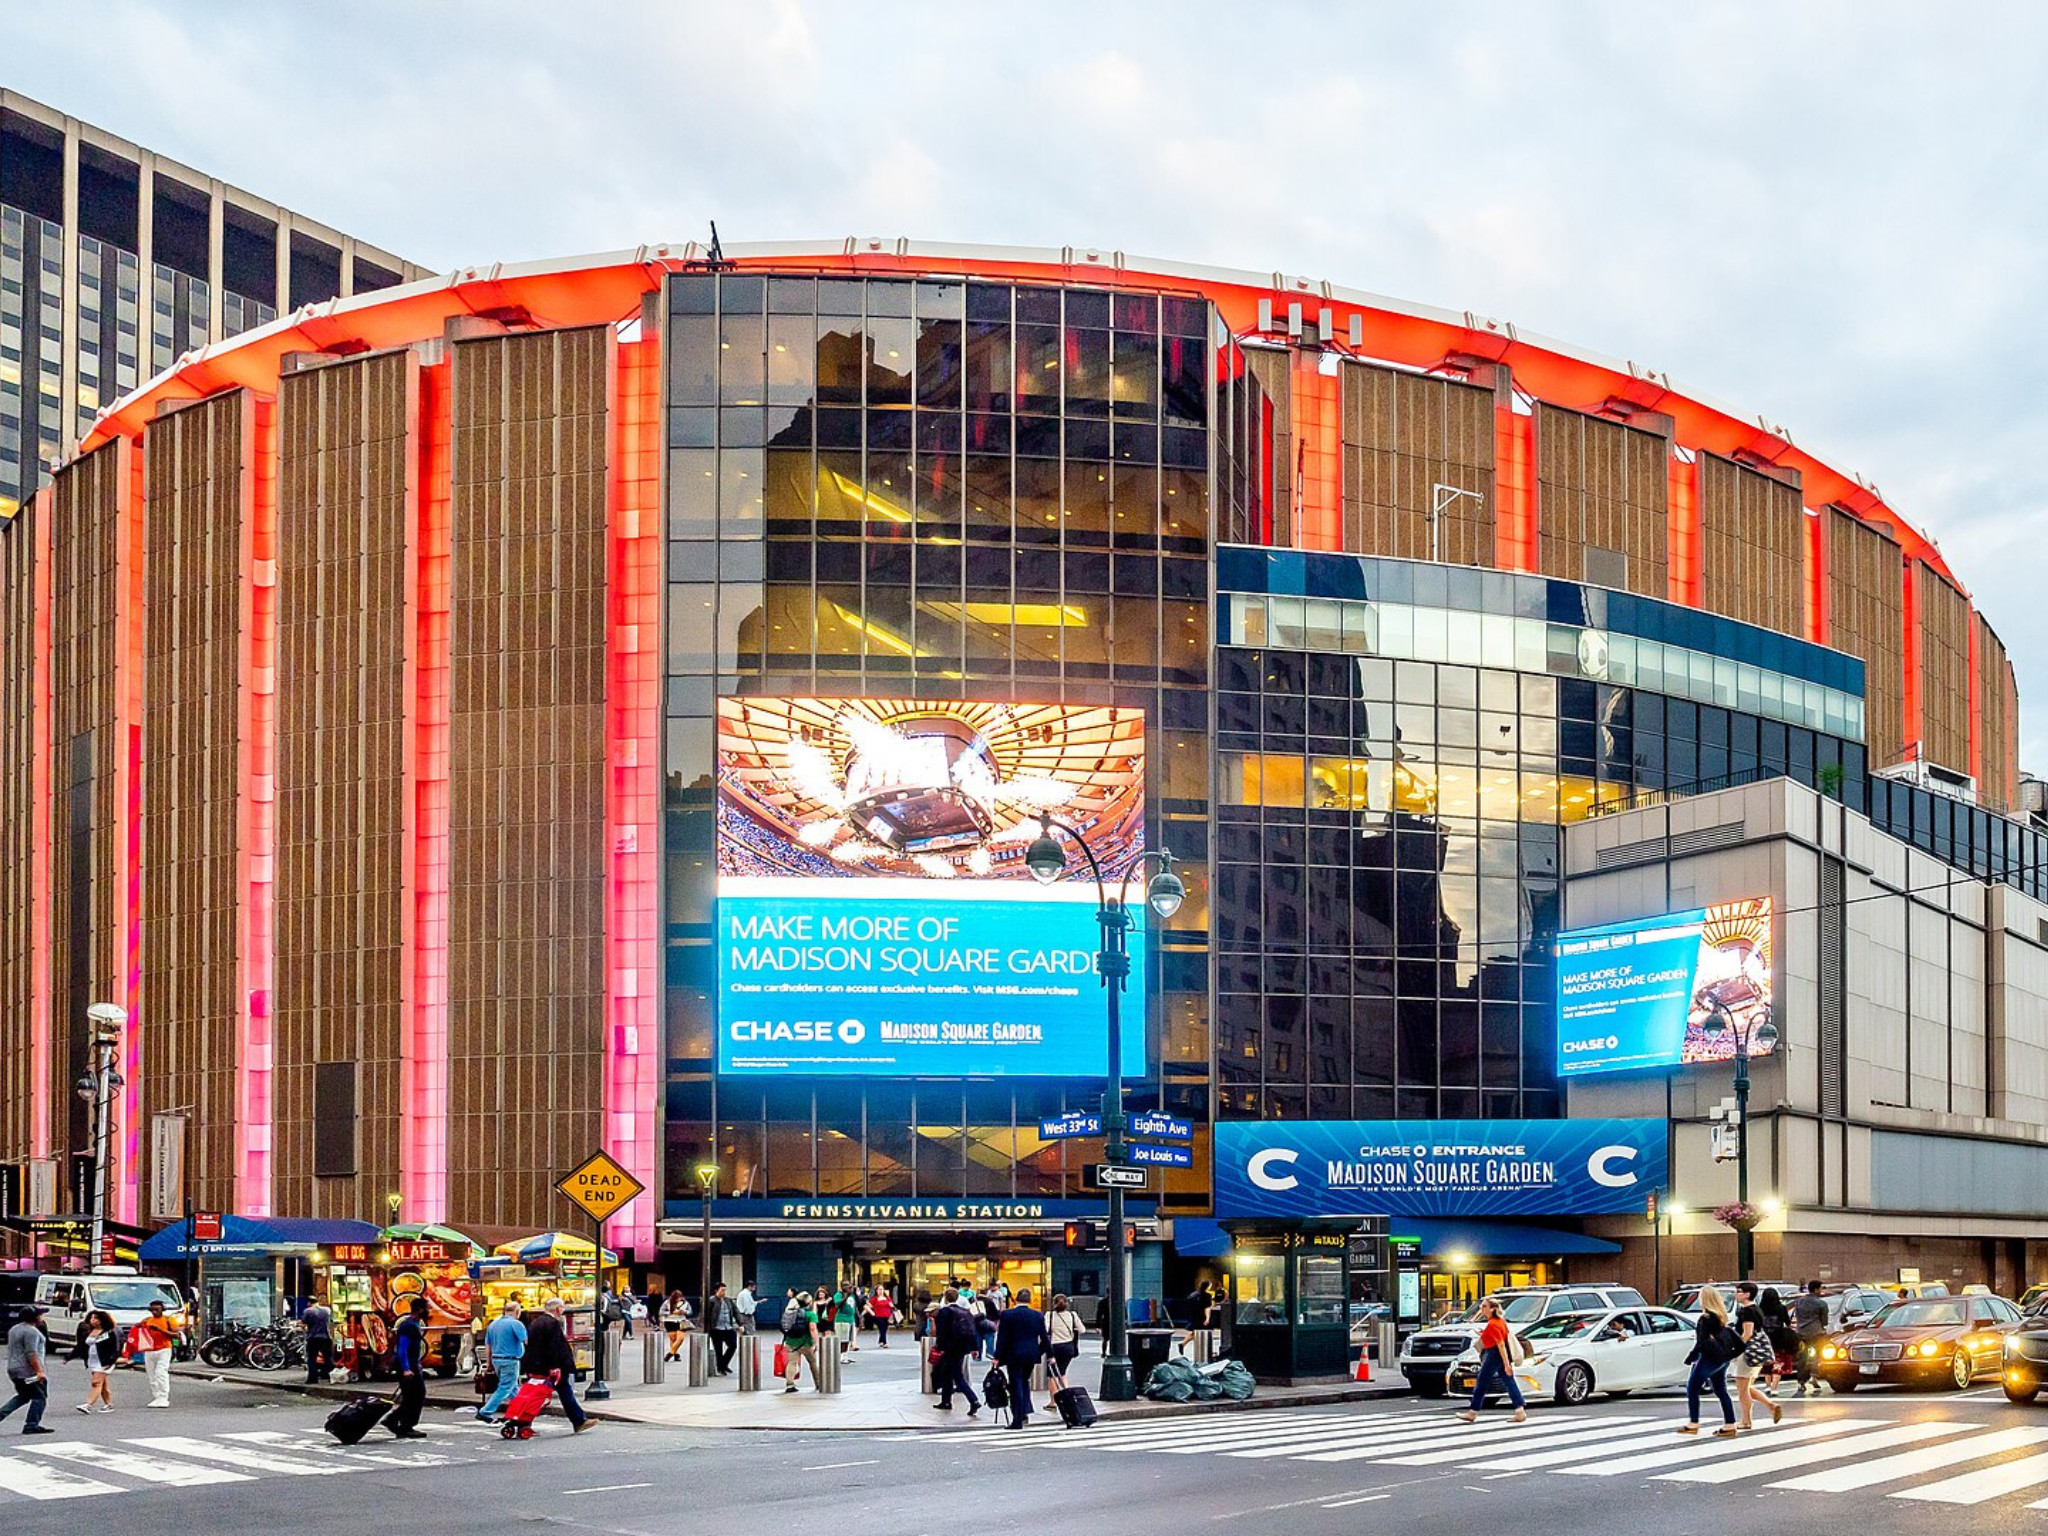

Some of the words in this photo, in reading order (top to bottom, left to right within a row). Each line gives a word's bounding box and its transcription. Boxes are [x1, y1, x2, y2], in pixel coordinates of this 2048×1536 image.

[731, 916, 812, 940] MAKE
[822, 916, 909, 941] MORE
[917, 917, 959, 941] OF
[731, 947, 872, 971] MADISON
[880, 947, 1000, 976] SQUARE
[1008, 949, 1101, 974] GARDE
[1562, 972, 1588, 985] MAKE
[1590, 967, 1618, 980] MORE
[1618, 965, 1633, 976] OF
[1562, 981, 1606, 995] MADISON
[1607, 974, 1646, 990] SQUARE
[1647, 968, 1688, 983] GARDEN
[731, 983, 761, 992] Chase
[764, 983, 823, 993] cardholders
[825, 985, 843, 993] can
[846, 985, 878, 993] access
[880, 985, 925, 994] exclusive
[927, 985, 970, 994] benefits.
[731, 1020, 834, 1041] CHASE
[881, 1021, 938, 1039] MADISON
[941, 1021, 989, 1041] SQUARE
[1563, 1038, 1605, 1053] CHASE
[1044, 1122, 1067, 1135] West
[1069, 1119, 1086, 1133] 33rd
[1088, 1118, 1099, 1131] St
[1134, 1118, 1167, 1134] Eighth
[1169, 1122, 1188, 1135] Ave
[1134, 1148, 1149, 1160] Joe
[1150, 1149, 1173, 1162] Louis
[1360, 1146, 1411, 1157] CHASE
[1433, 1145, 1526, 1156] ENTRANCE
[1247, 1148, 1299, 1191] C
[1328, 1160, 1406, 1185] MADISON
[1413, 1160, 1480, 1186] SQUARE
[1588, 1145, 1638, 1187] C
[579, 1174, 621, 1186] DEAD
[1104, 1171, 1118, 1181] ONE
[1125, 1173, 1141, 1181] WAY
[585, 1190, 616, 1202] END
[783, 1205, 947, 1217] PENNSYLVANIA
[956, 1205, 1042, 1217] STATION
[1322, 1235, 1340, 1246] TAXI
[335, 1245, 349, 1260] HOT
[351, 1245, 366, 1260] DOG
[387, 1244, 450, 1260] ALAFEL
